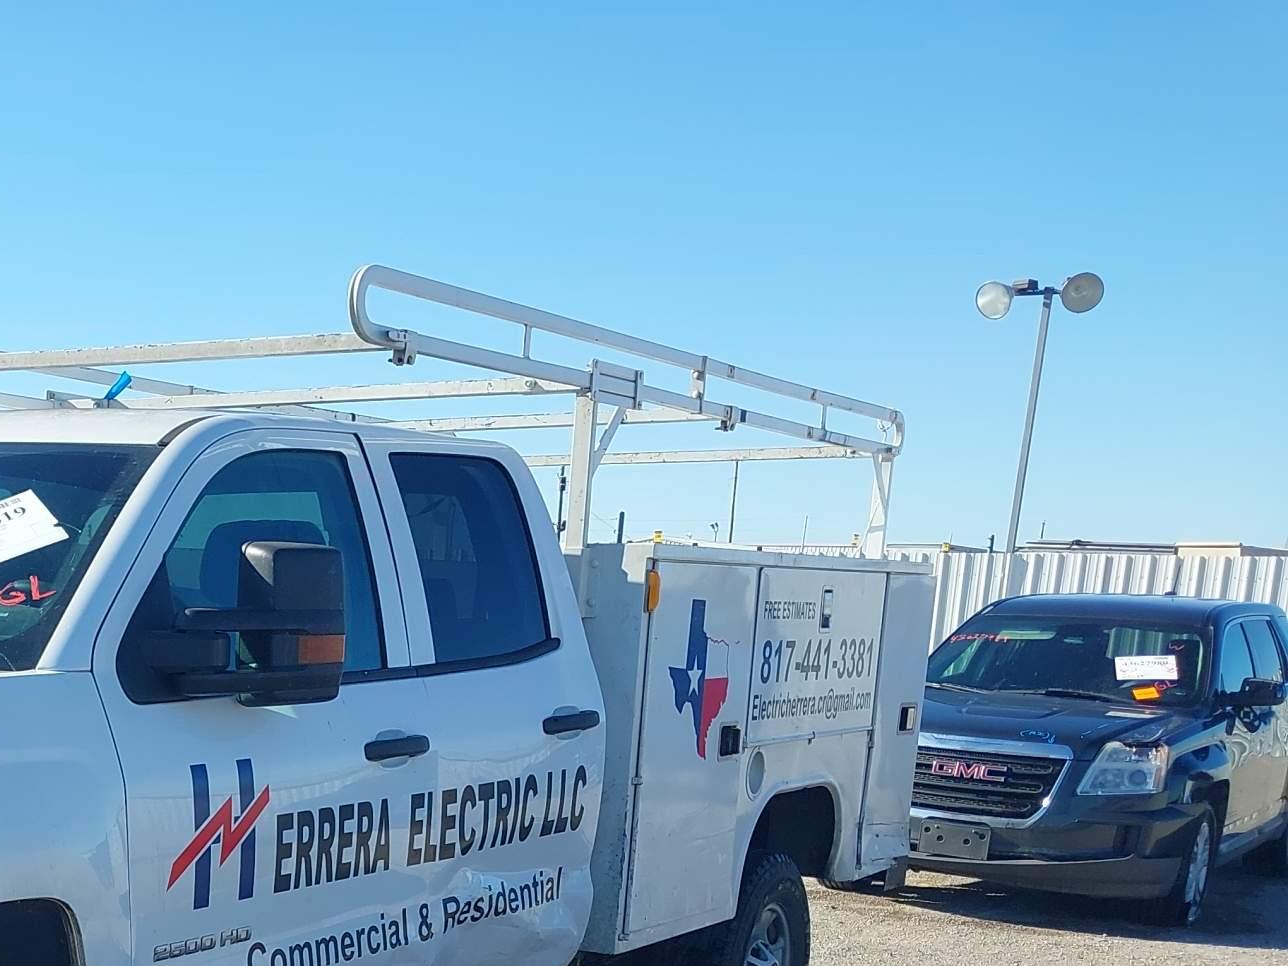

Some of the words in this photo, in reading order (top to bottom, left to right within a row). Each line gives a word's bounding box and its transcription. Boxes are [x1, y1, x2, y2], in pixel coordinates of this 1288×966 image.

[763, 601, 781, 619] FREE
[782, 601, 816, 619] ESTIMATES
[760, 638, 874, 684] 817-441-3381
[931, 760, 1008, 783] GMC
[406, 773, 538, 867] ELECTRIC
[539, 764, 587, 838] LLC
[418, 903, 434, 942] &
[442, 866, 563, 935] Residential
[153, 933, 217, 962] 2500
[220, 926, 253, 947] HD
